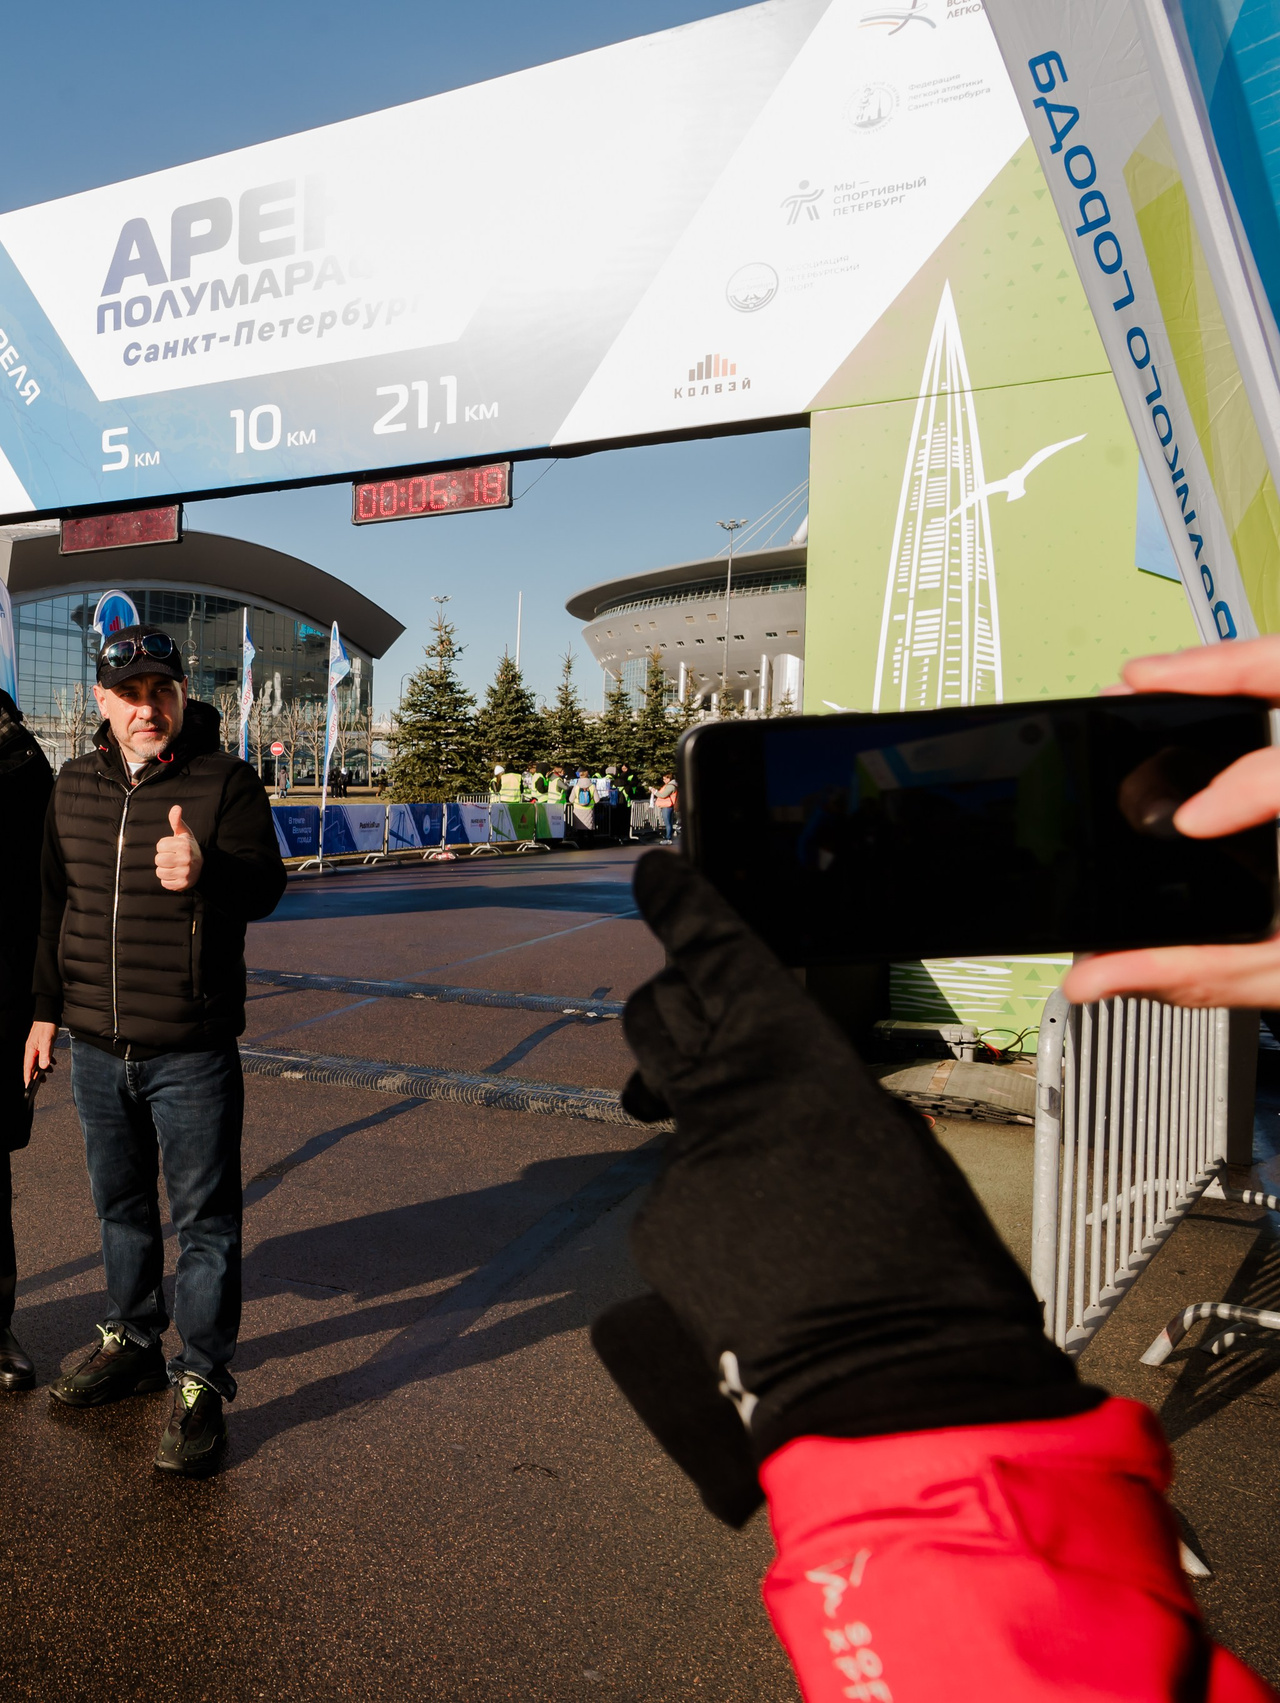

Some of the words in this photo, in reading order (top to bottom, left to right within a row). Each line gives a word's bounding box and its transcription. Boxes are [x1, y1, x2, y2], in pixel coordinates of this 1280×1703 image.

[947, 3, 984, 19] ЛЕГКО
[908, 73, 961, 91] Федерация
[907, 87, 991, 111] Санкт-Петербурга
[833, 180, 855, 192] МЫ
[833, 176, 927, 204] СПОРТИВНЫЙ
[833, 194, 907, 217] ПЕТЕРБУРГ
[674, 377, 751, 400] КОЛВЭЙ
[372, 374, 458, 435] 21,1
[229, 403, 282, 454] 10
[101, 427, 130, 472] 5
